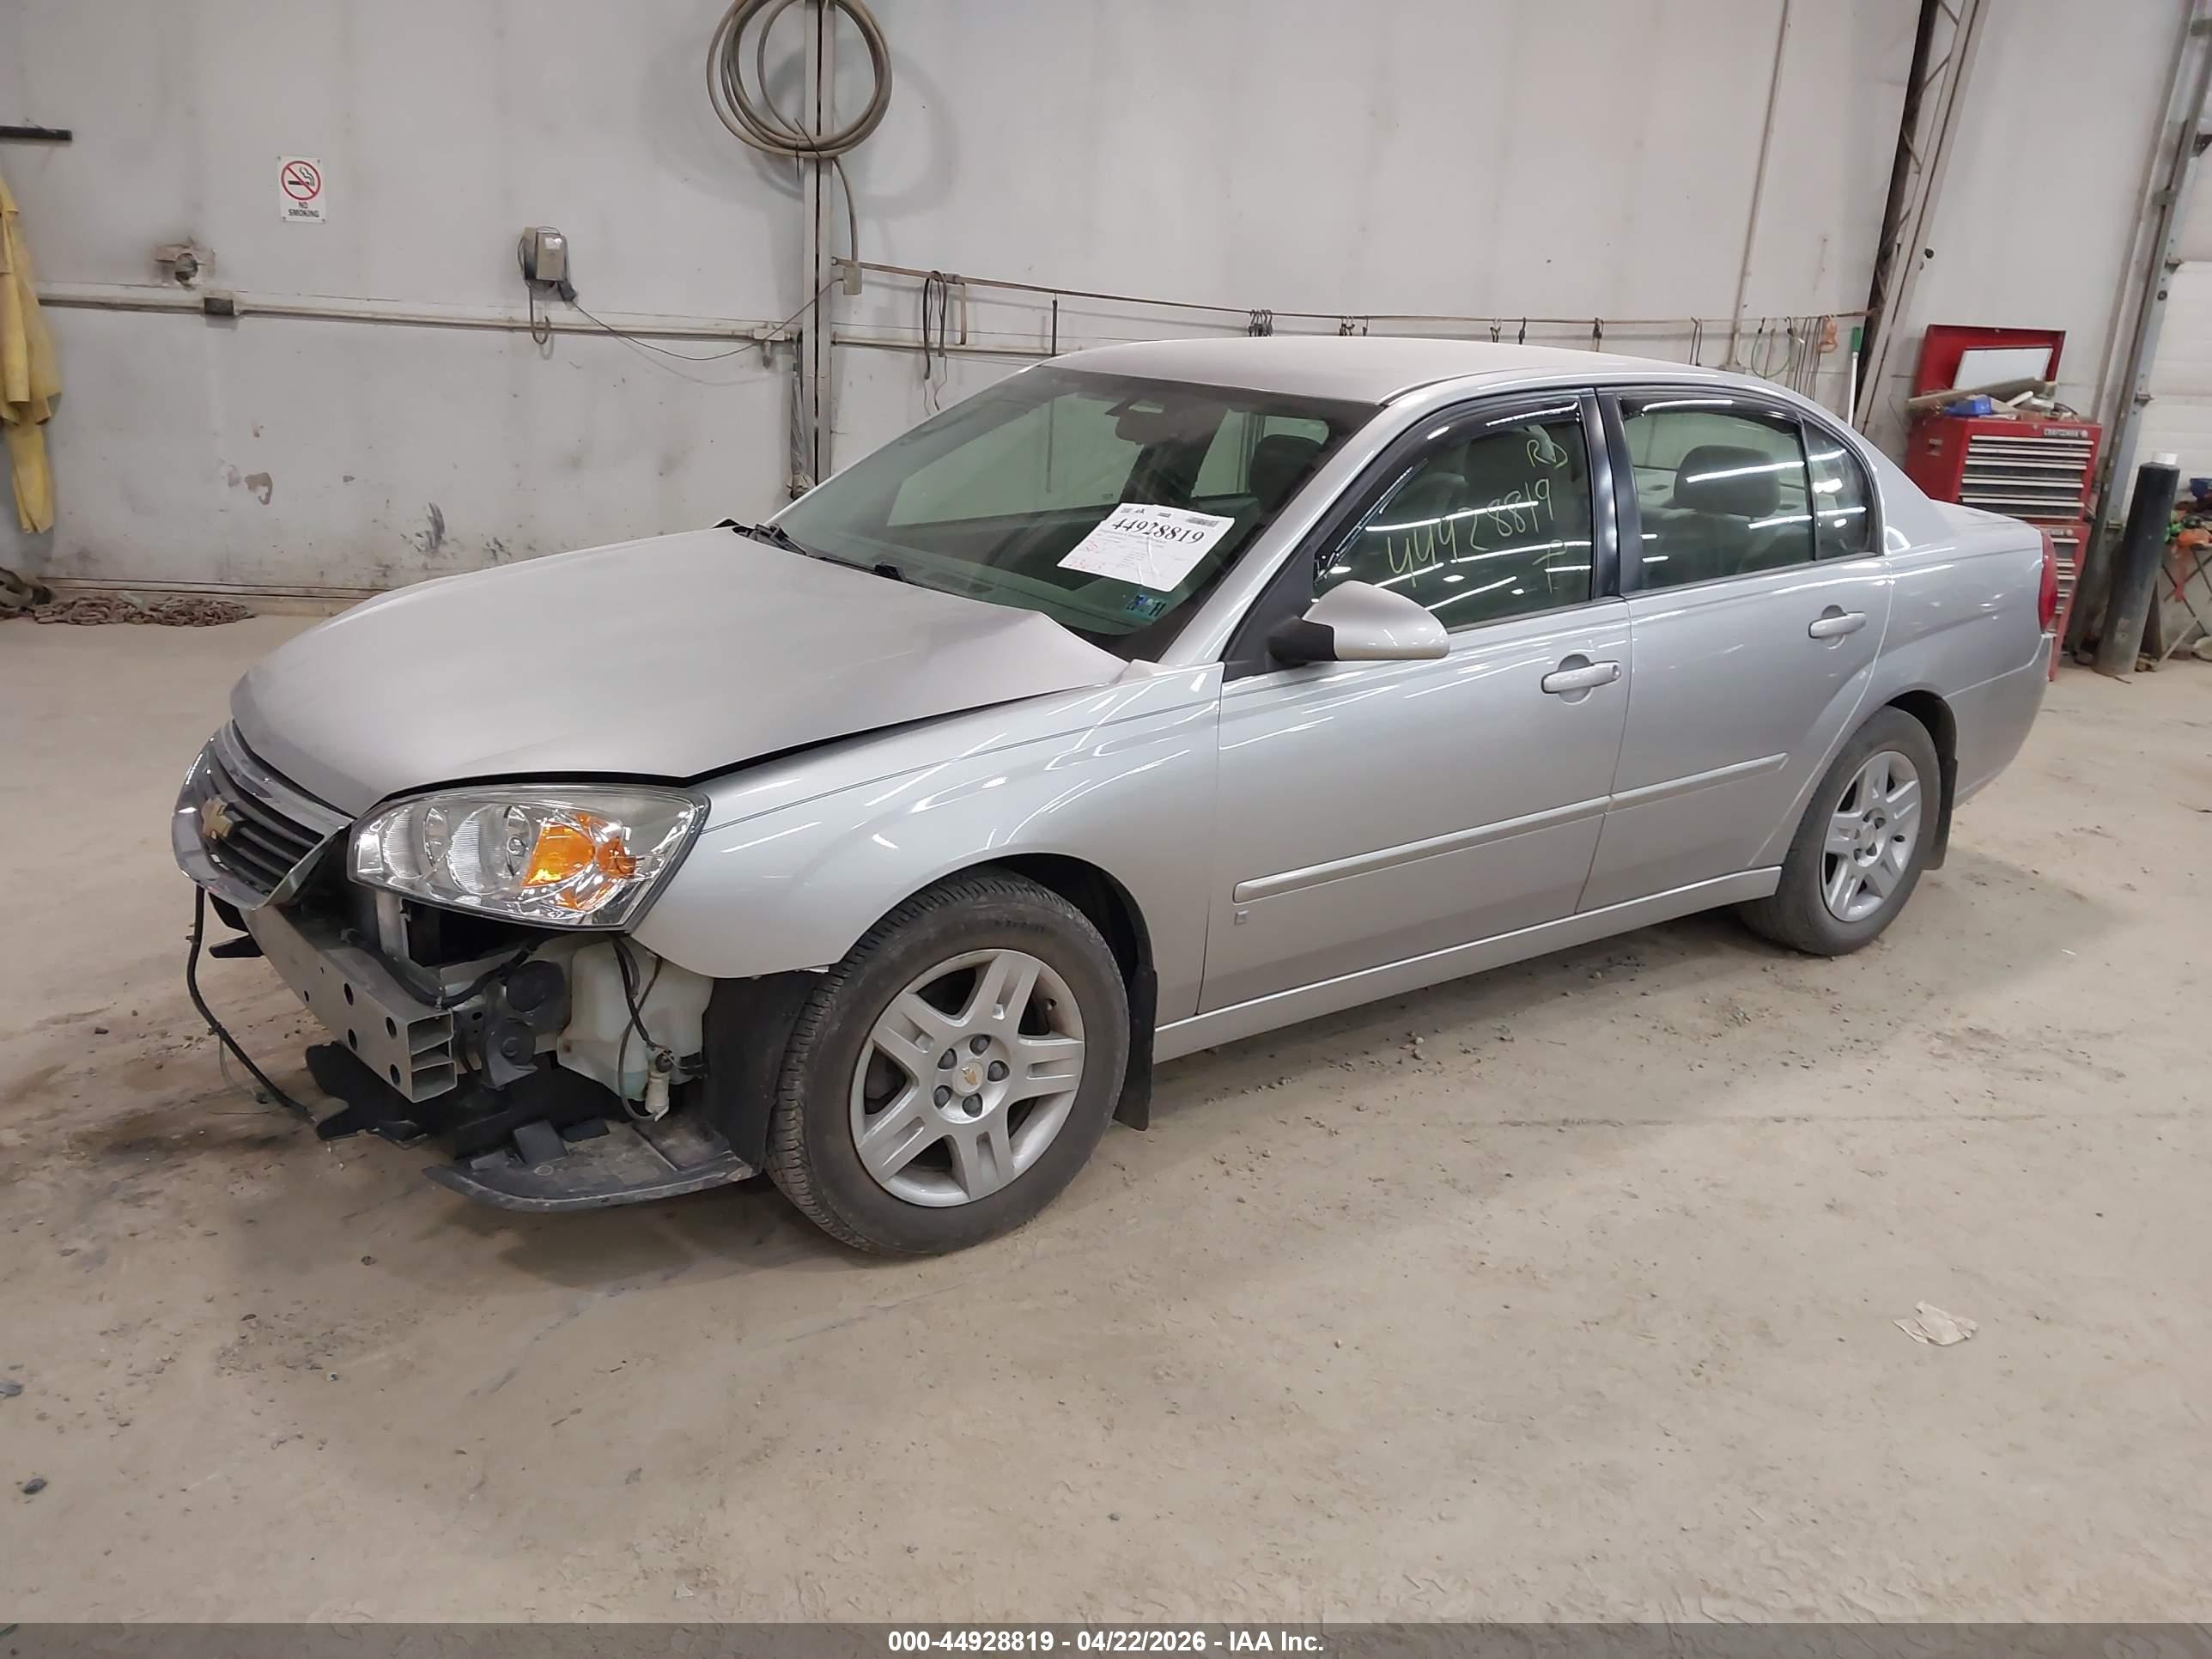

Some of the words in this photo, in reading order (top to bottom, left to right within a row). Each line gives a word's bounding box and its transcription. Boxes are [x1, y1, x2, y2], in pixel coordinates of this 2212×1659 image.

[288, 209, 319, 218] SMOKING
[1112, 518, 1206, 544] 44928819
[1387, 477, 1554, 588] 44928819
